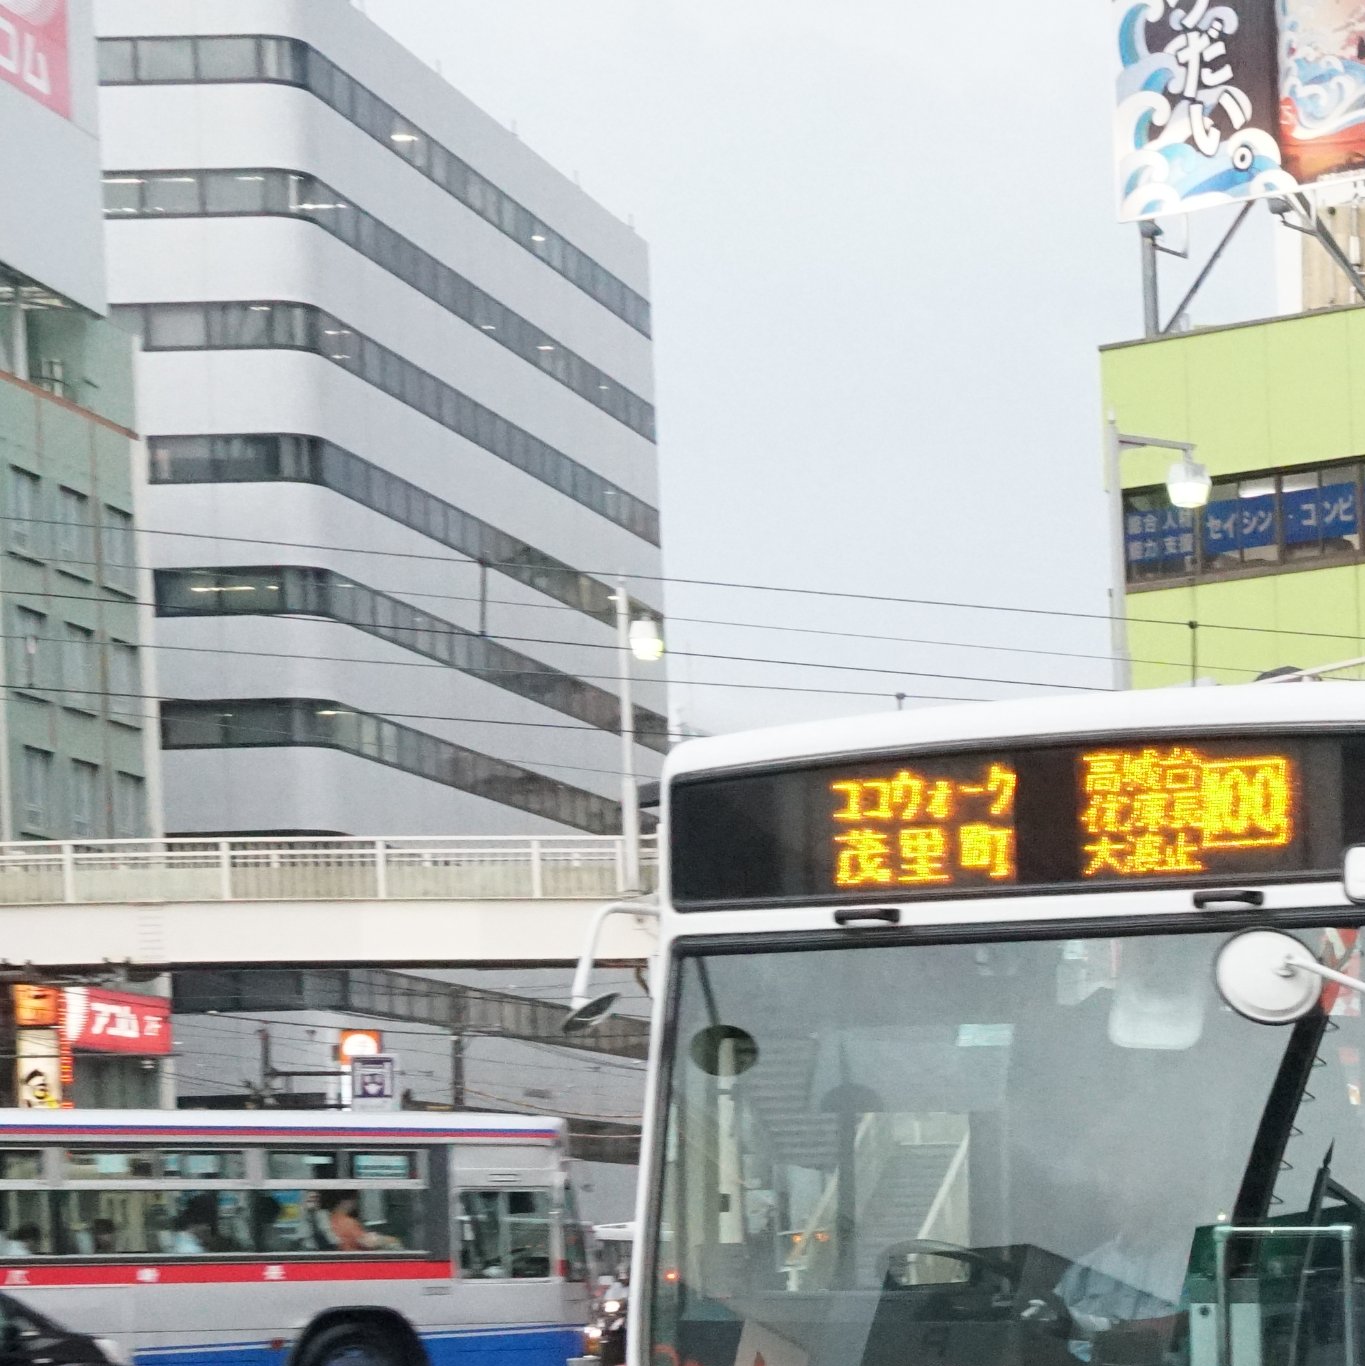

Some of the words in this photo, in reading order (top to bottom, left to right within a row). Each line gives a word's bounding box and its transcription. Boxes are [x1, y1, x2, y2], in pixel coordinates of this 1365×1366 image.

[832, 765, 1016, 820] ココウォーク
